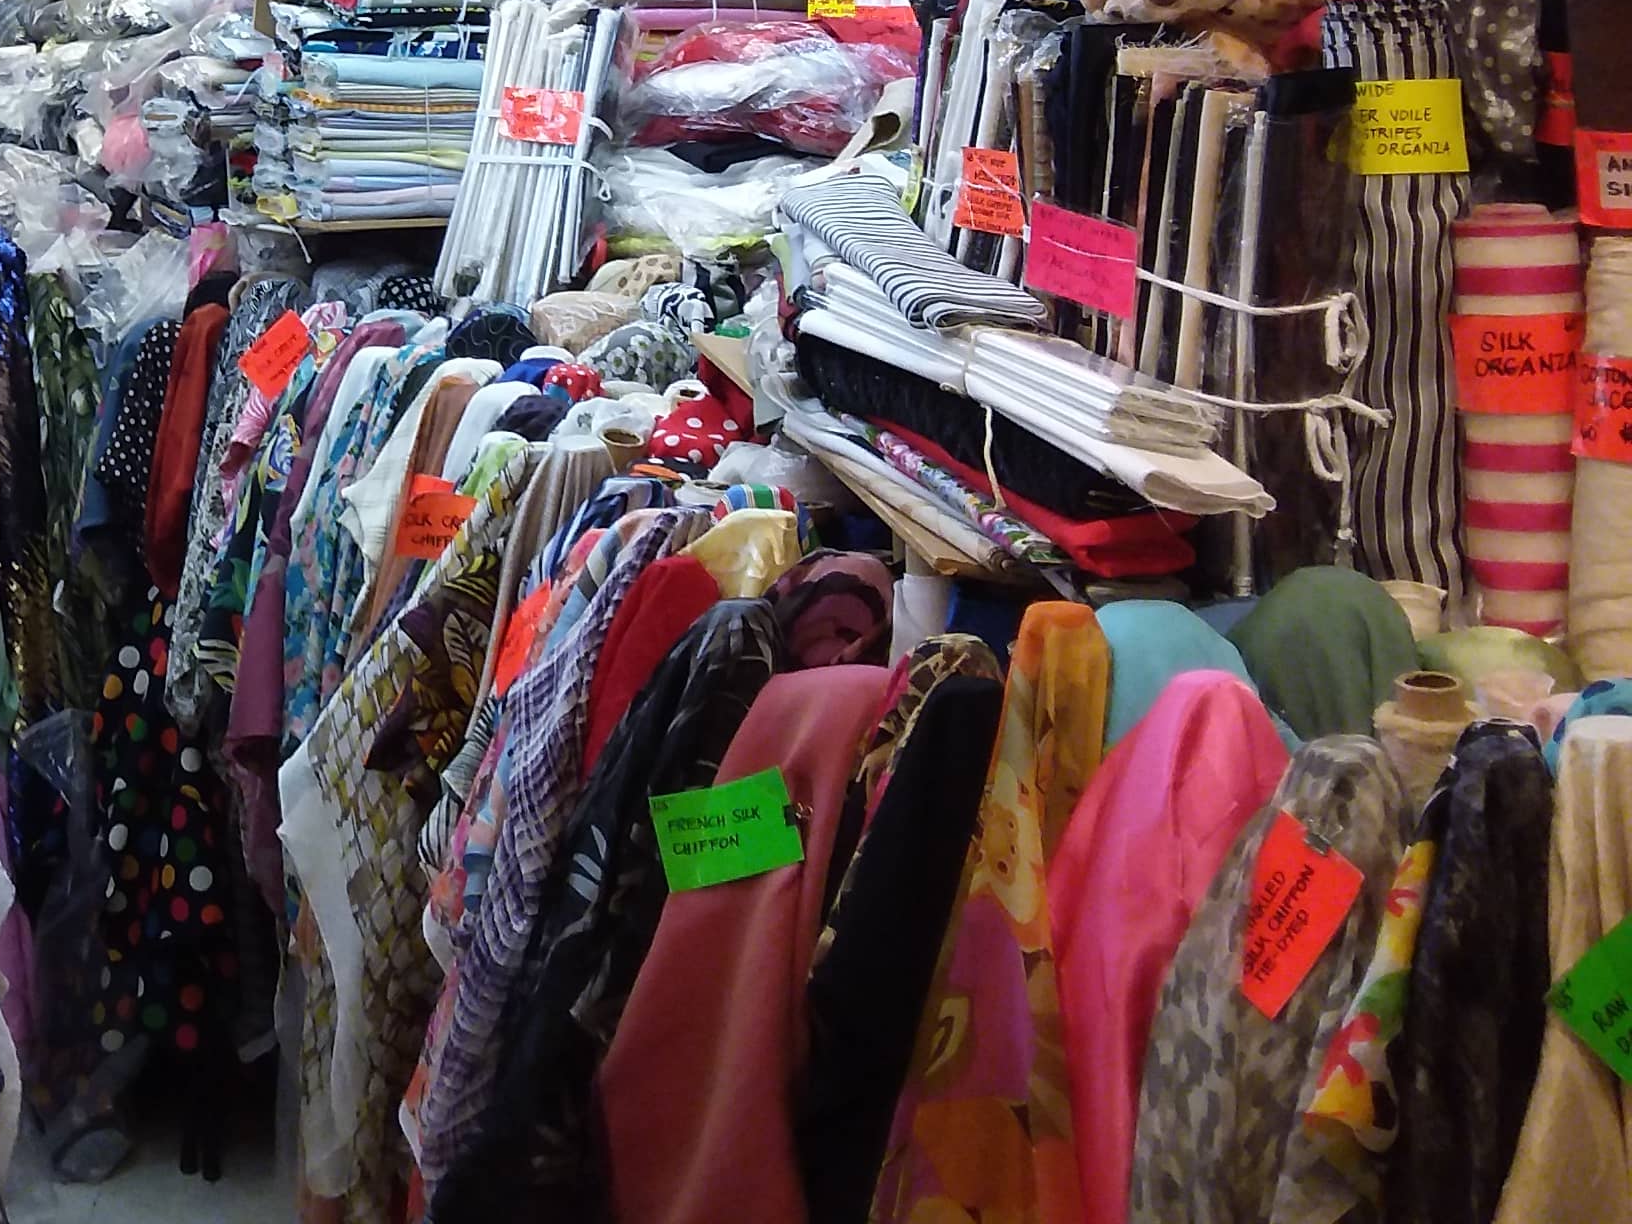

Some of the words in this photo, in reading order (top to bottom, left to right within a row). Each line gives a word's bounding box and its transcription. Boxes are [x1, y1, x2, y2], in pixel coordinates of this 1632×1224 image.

[1390, 107, 1433, 121] VOILE
[1480, 331, 1536, 352] SILK
[1475, 350, 1577, 378] ORGANZA
[667, 815, 726, 834] FRENCH
[732, 805, 761, 823] SILK
[672, 832, 740, 857] CHIFFON
